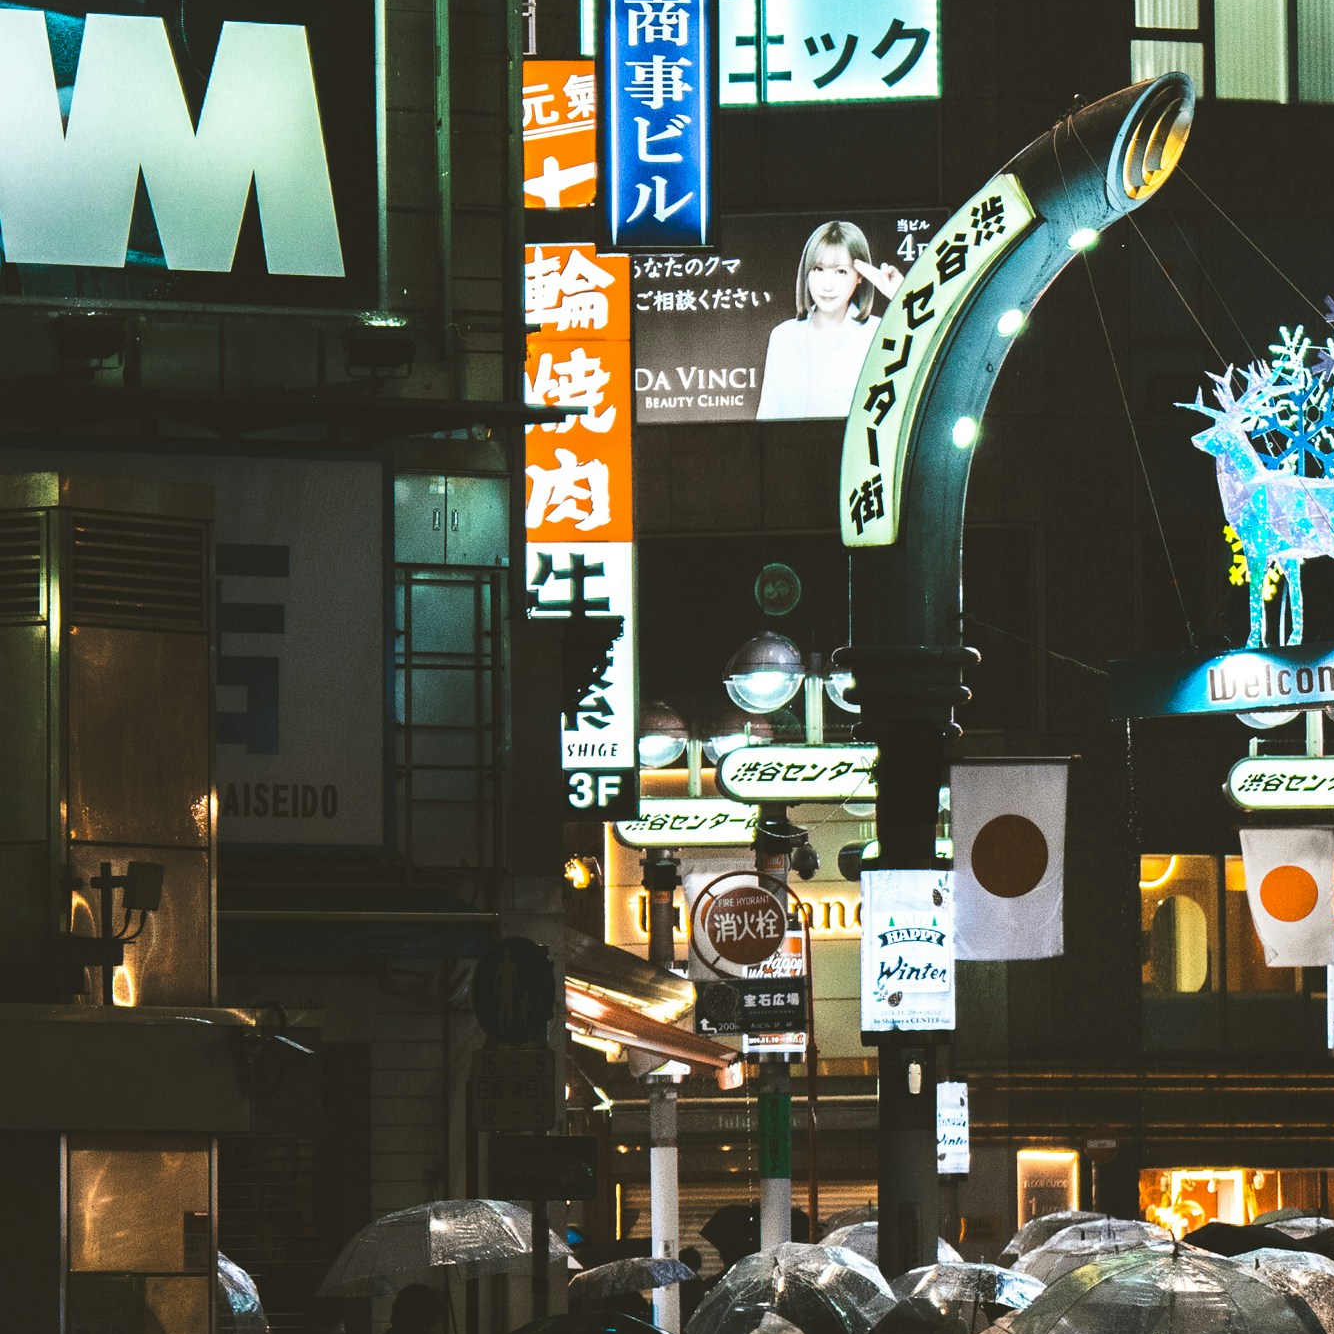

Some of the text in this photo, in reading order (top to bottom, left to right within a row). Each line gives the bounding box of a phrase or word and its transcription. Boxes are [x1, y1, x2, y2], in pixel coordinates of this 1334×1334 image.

[636, 288, 771, 312] ご相談ください
[635, 365, 757, 392] DA VINCI
[849, 195, 1006, 536] 渋谷センター街
[568, 774, 622, 808] 3F
[718, 895, 770, 907] FIRE HYDRANT
[714, 908, 780, 944] 消火栓
[885, 928, 941, 945] HAPPY
[877, 954, 948, 984] Winter
[743, 992, 800, 1008] 宝石広場
